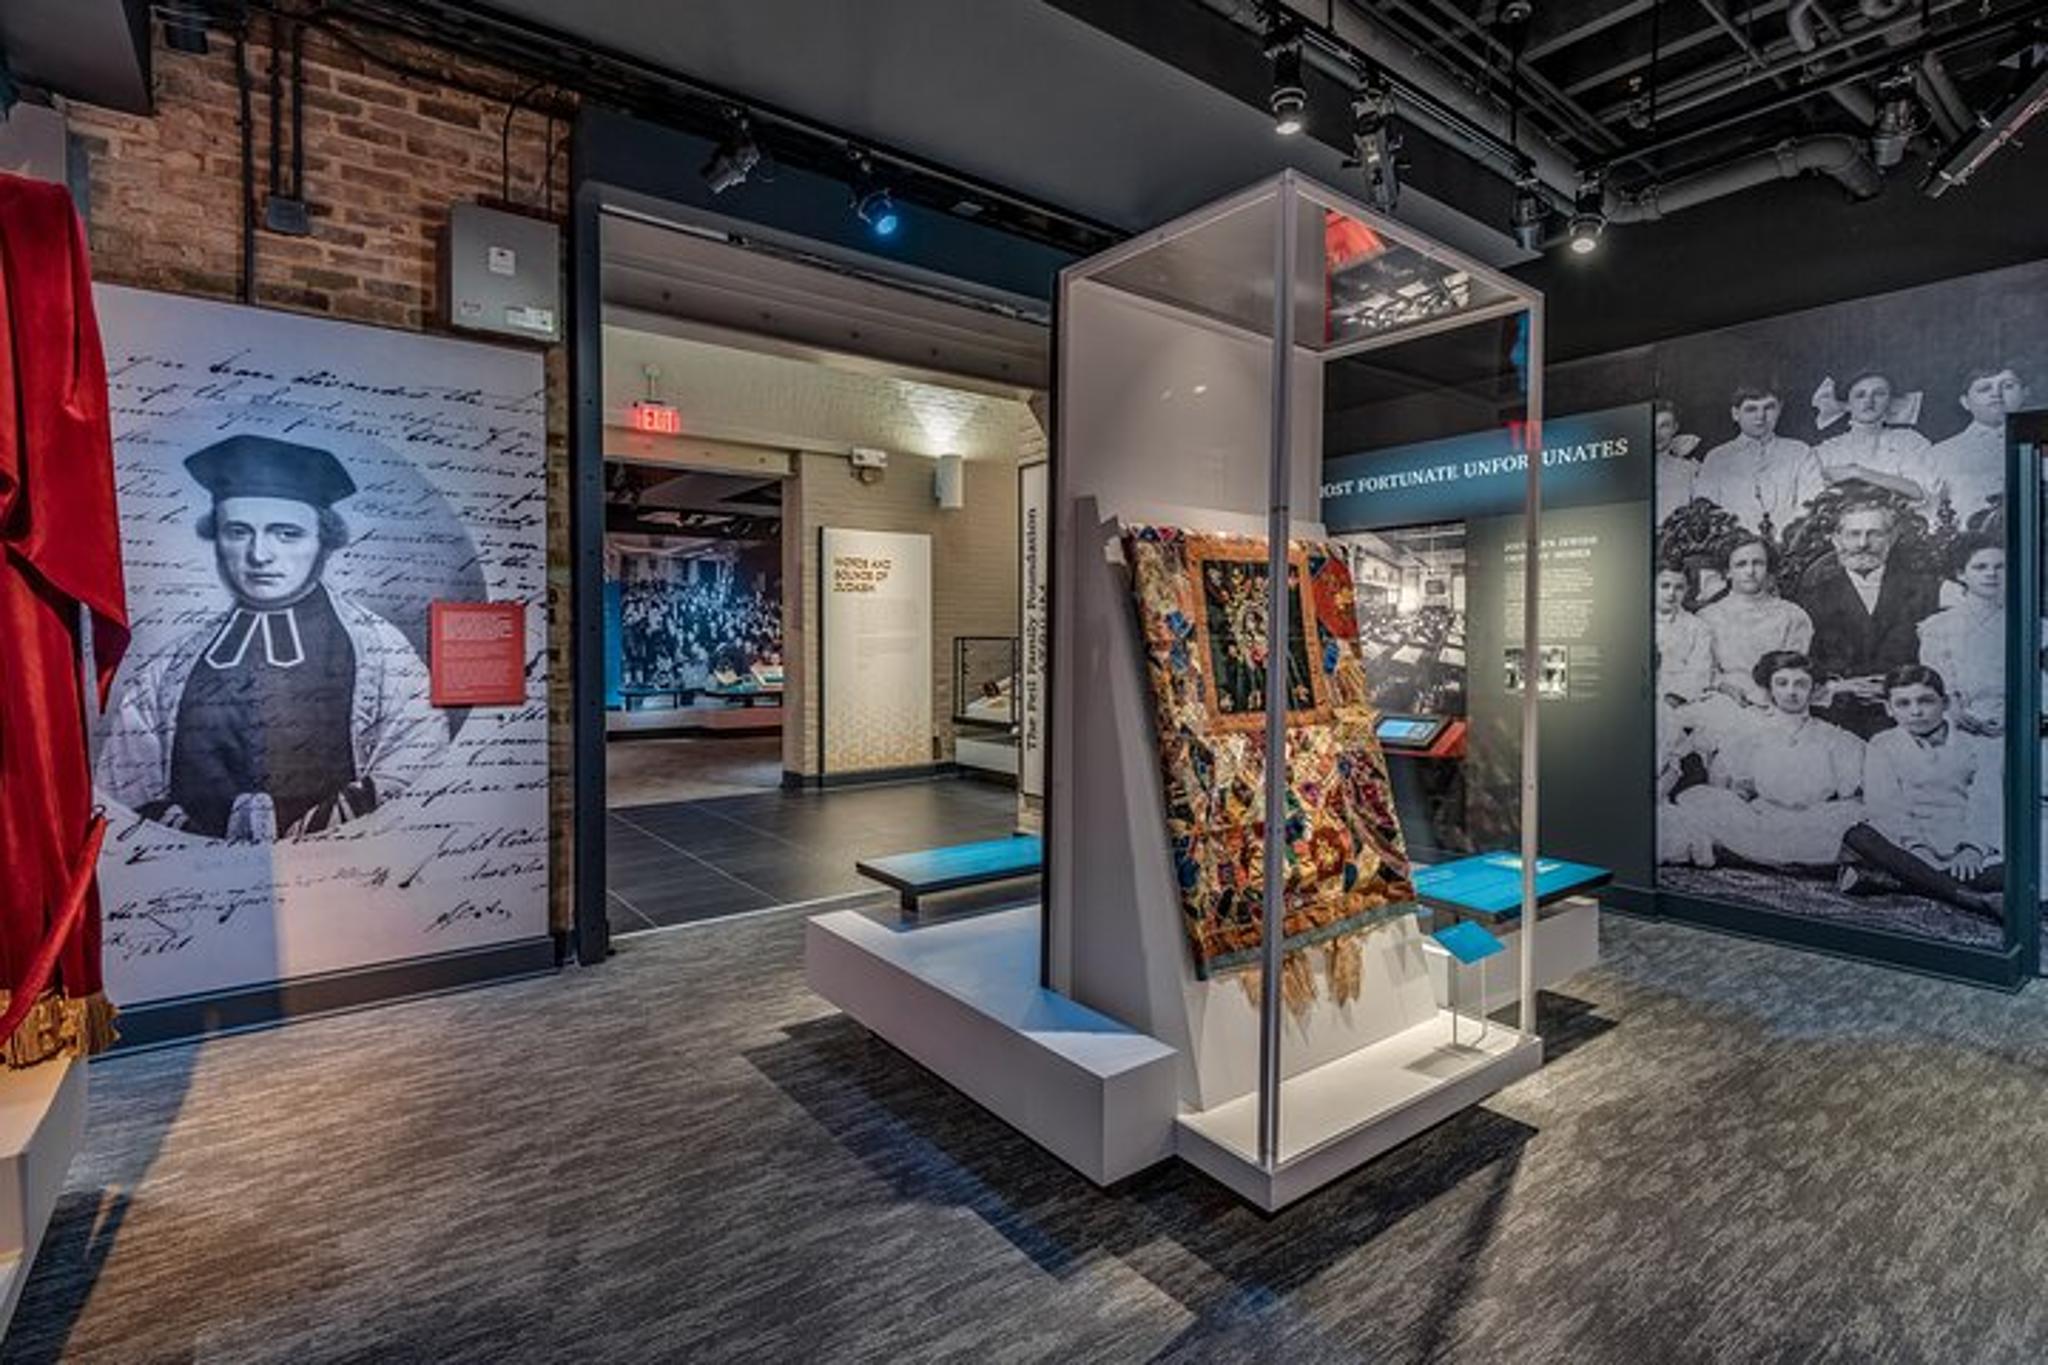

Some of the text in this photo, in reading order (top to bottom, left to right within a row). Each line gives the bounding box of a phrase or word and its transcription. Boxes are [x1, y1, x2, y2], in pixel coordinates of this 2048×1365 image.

[643, 408, 674, 432] EXIT
[1358, 465, 1458, 493] FORTUNATE
[1464, 438, 1628, 478] UNFORUNATES
[1026, 508, 1037, 610] Foundation
[1026, 617, 1038, 676] Family
[1026, 717, 1037, 750] The
